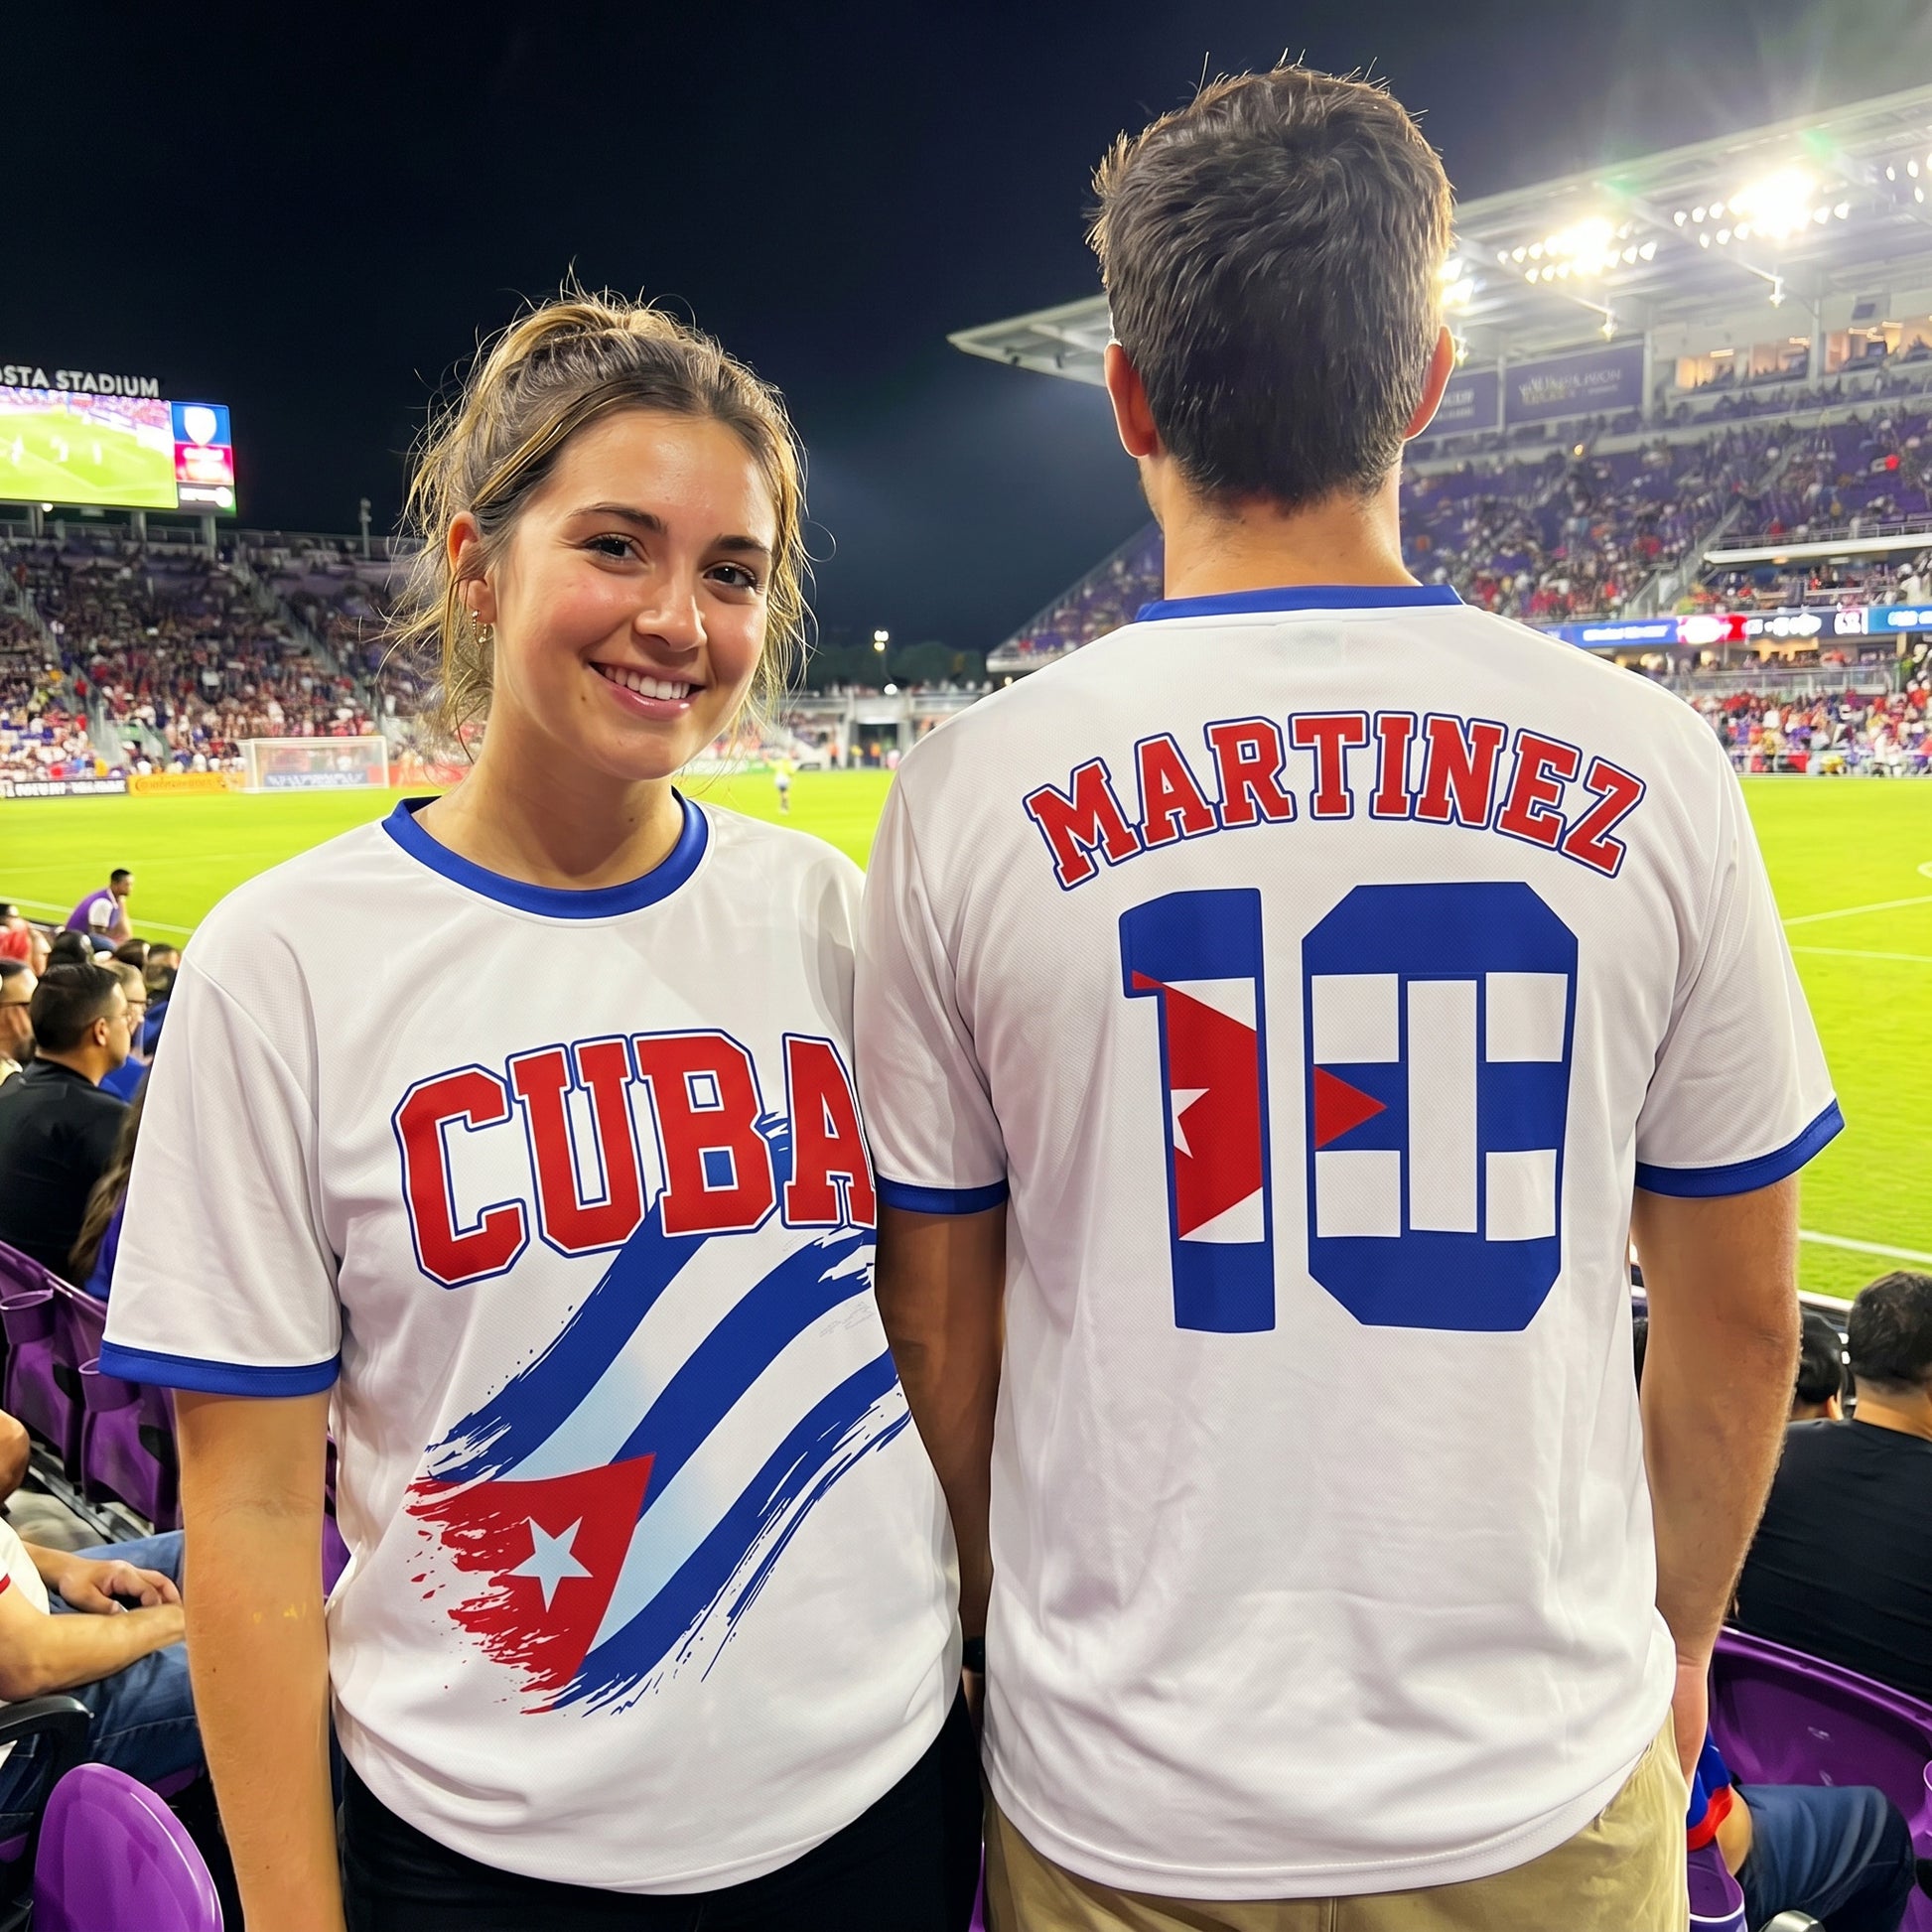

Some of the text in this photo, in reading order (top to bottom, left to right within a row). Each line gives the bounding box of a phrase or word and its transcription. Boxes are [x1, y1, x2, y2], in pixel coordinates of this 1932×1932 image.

[0, 364, 159, 398] STA STADIUM
[1023, 710, 1647, 892] MARTINEZ
[391, 1029, 877, 1290] CUBA
[1119, 882, 1579, 1332] 10
